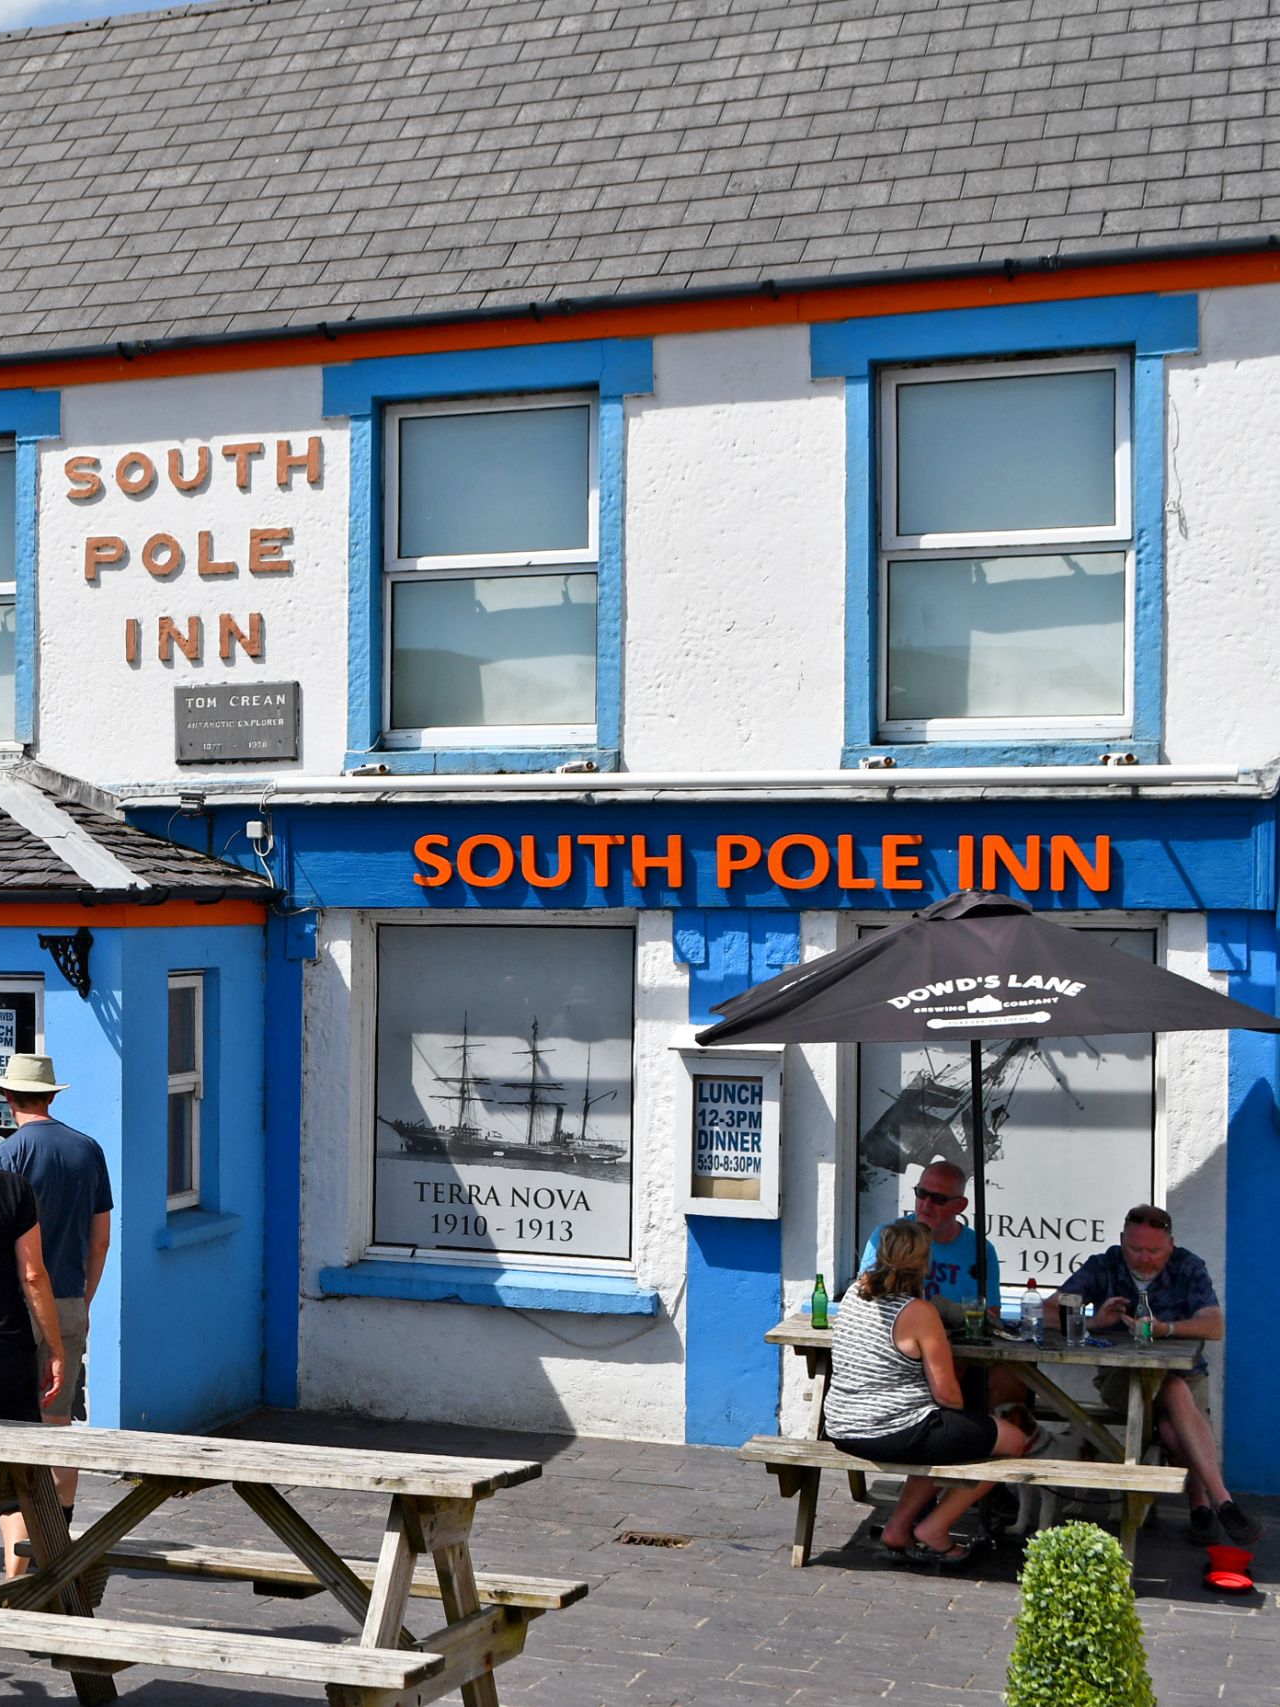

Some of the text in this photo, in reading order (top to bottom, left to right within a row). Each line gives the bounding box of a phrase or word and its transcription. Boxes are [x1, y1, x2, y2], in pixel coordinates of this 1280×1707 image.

[64, 436, 321, 499] SOUTH
[84, 527, 293, 581] POLE
[125, 612, 262, 662] INN
[186, 694, 286, 709] TOM CREAN
[237, 718, 285, 727] EXPLORER
[413, 834, 1110, 891] SOUTH POLE INN
[887, 974, 1087, 1009] DOWD'S LANE
[1003, 997, 1059, 1008] COMPANY
[699, 1083, 762, 1105] LUNCH
[698, 1109, 762, 1129] 12-3PM
[697, 1130, 761, 1153] DINNER
[697, 1154, 761, 1173] 5:30-8:30PM
[413, 1181, 593, 1212] TERRA NOVA
[431, 1213, 488, 1237] 1910
[515, 1218, 574, 1242] 1913
